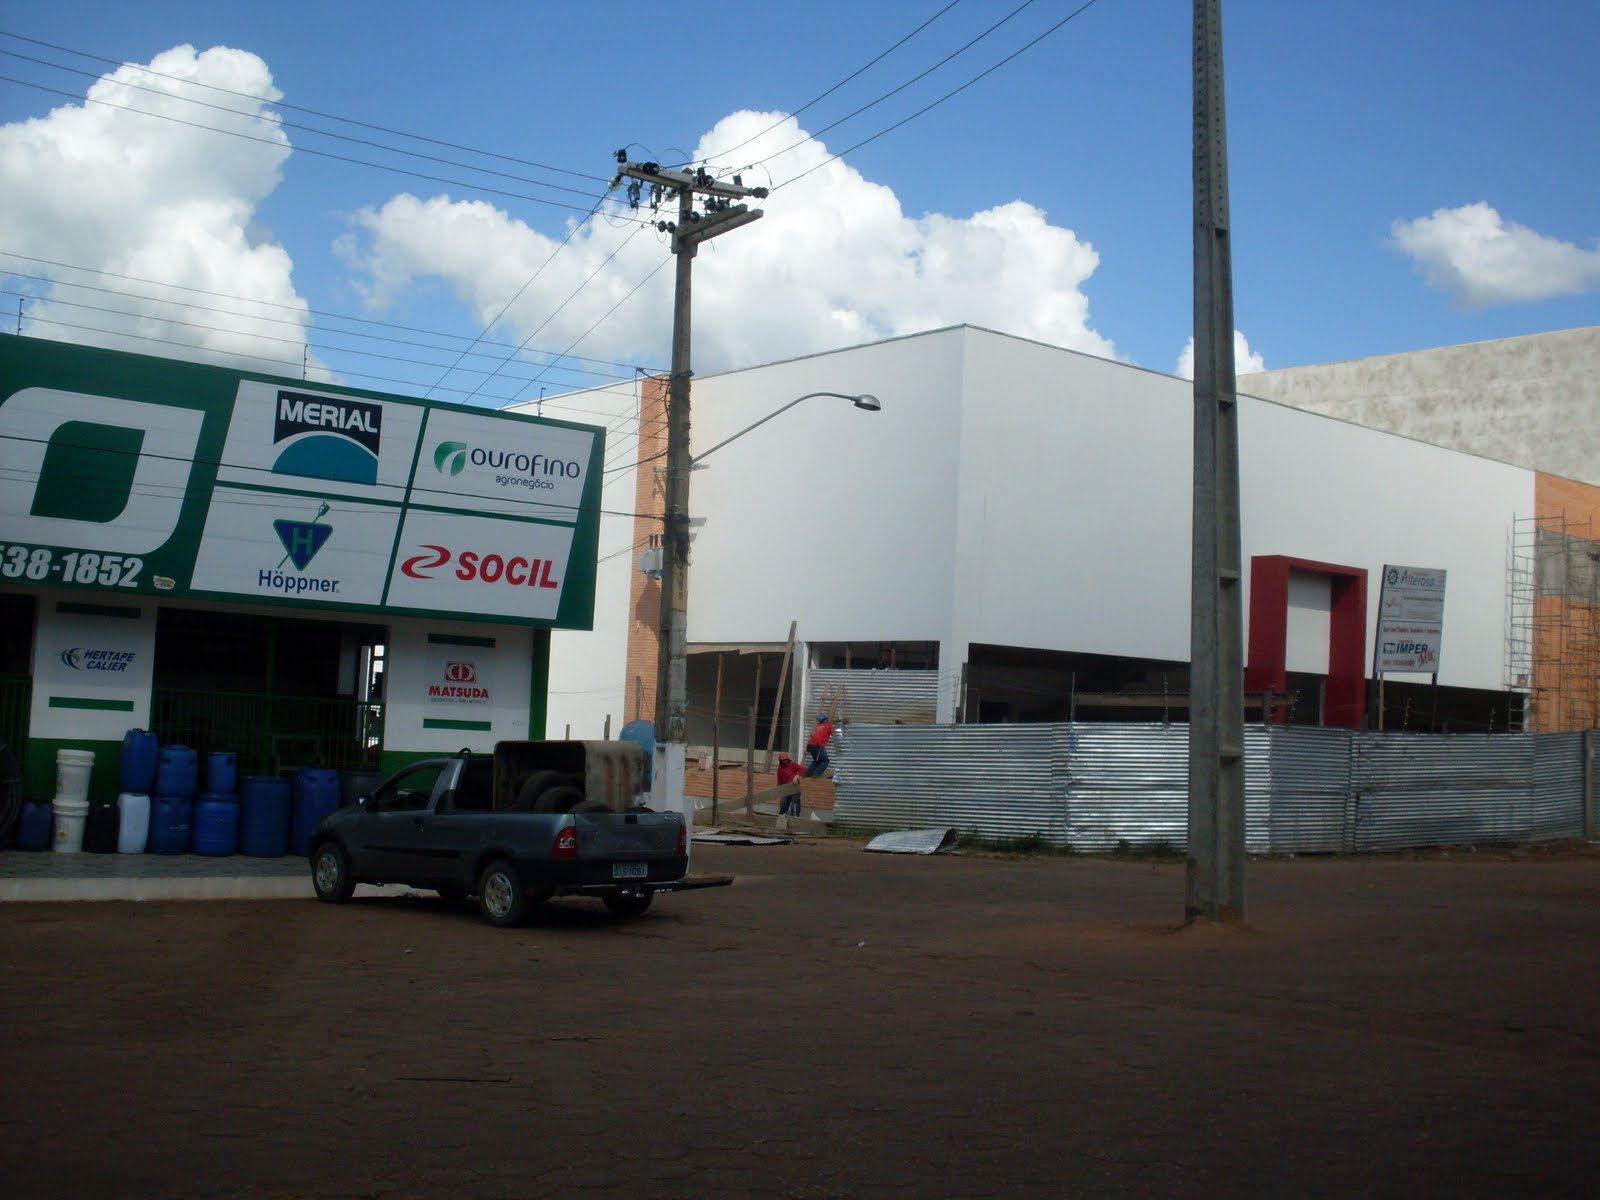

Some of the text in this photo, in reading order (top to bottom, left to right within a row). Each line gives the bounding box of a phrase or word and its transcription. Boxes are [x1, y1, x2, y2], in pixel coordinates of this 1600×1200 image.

[279, 398, 379, 434] MERIAL
[470, 448, 581, 479] ourofino
[495, 475, 555, 490] agronegócio
[455, 551, 559, 589] SOCIL
[258, 569, 339, 593] Höppner
[84, 650, 136, 662] HERTAPE
[1396, 643, 1429, 655] IMPER
[86, 660, 127, 672] CALIER
[429, 685, 489, 699] MATSUDA
